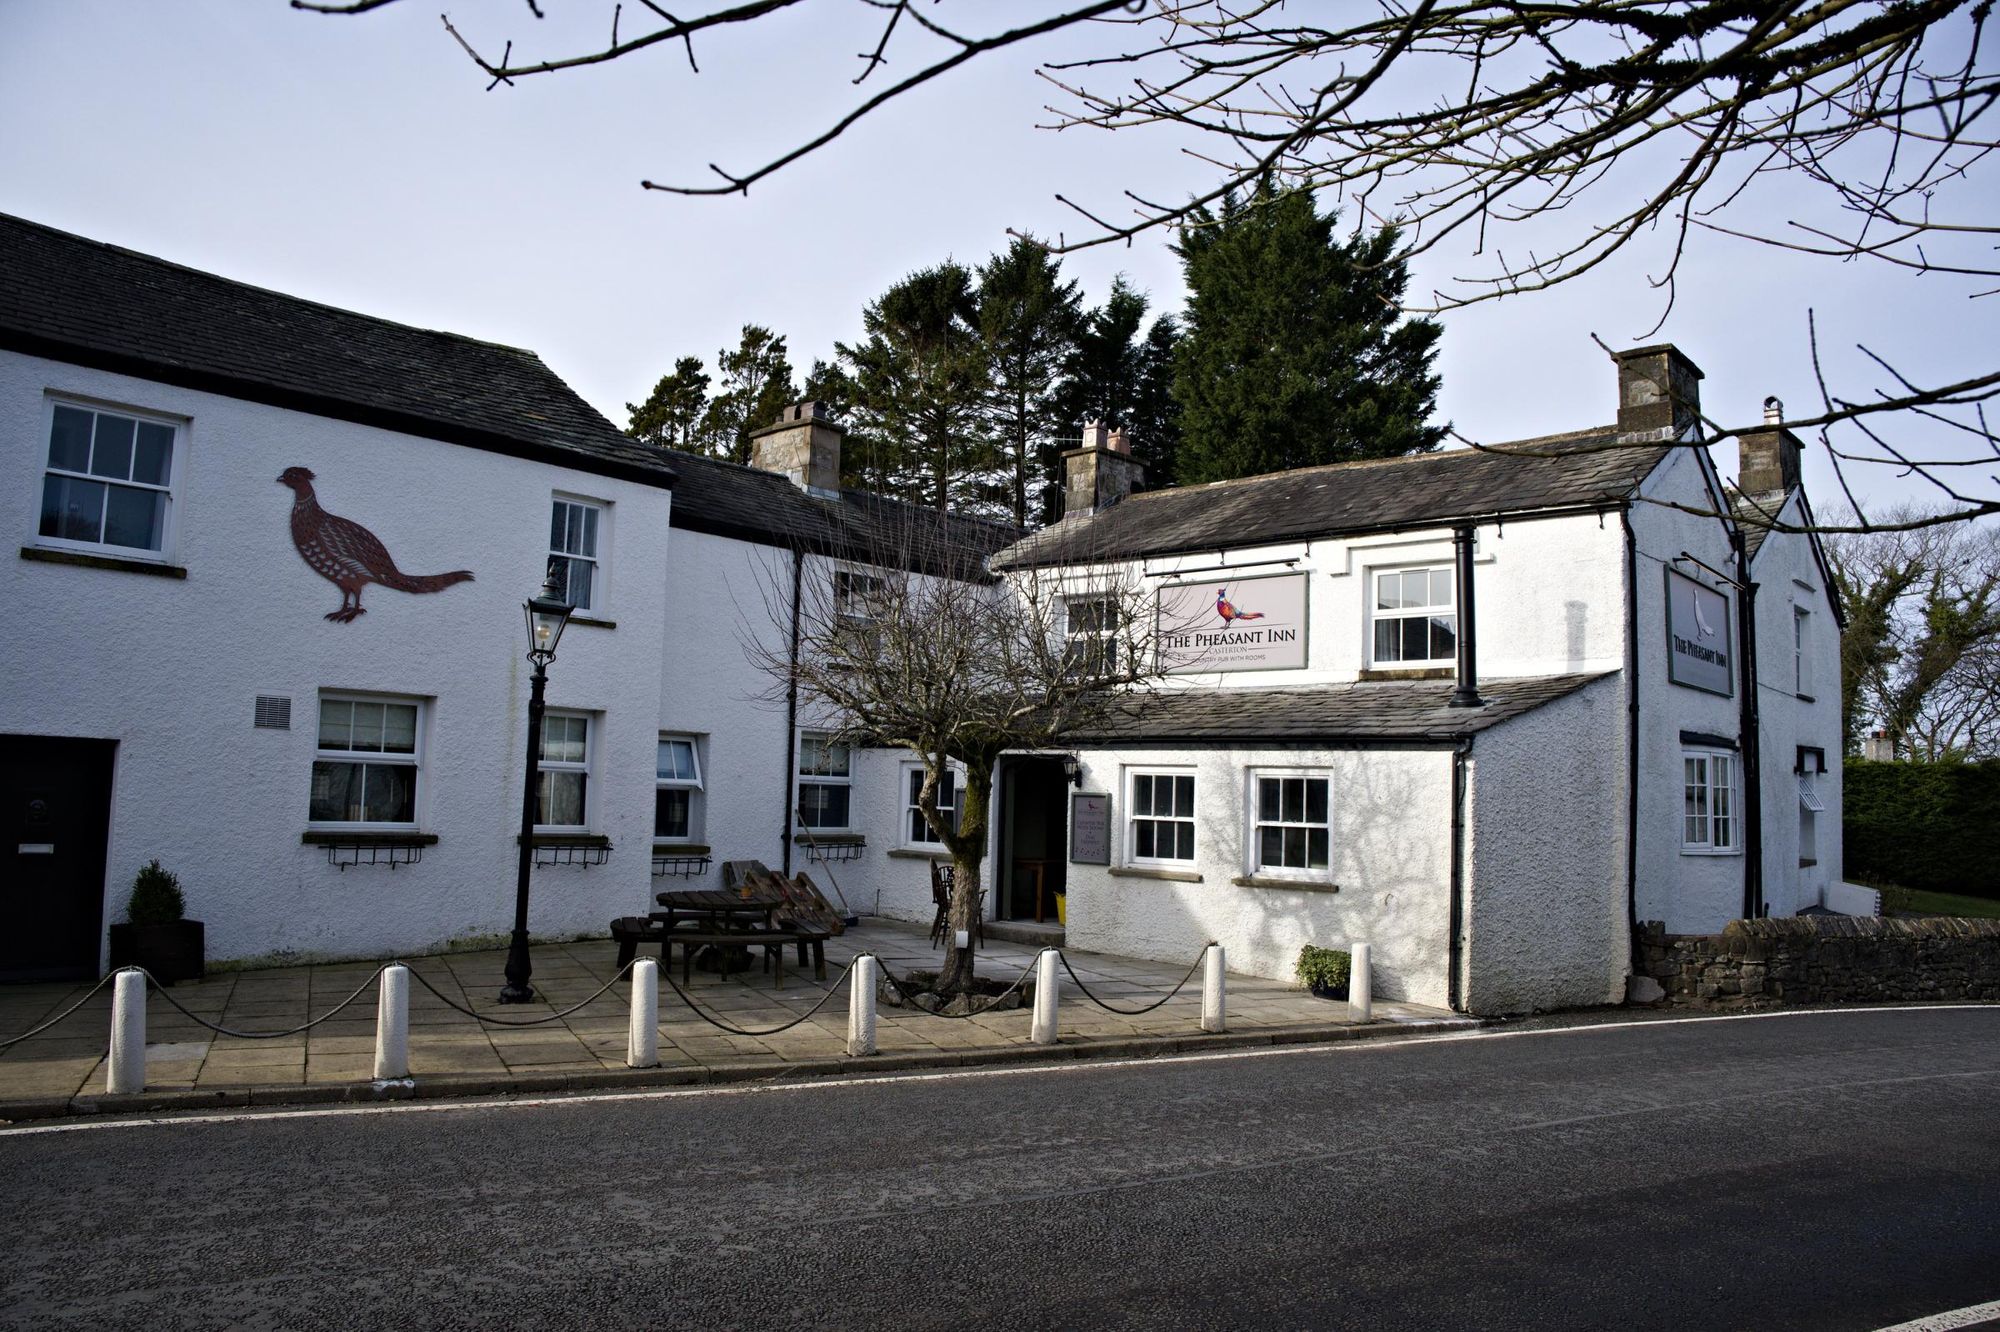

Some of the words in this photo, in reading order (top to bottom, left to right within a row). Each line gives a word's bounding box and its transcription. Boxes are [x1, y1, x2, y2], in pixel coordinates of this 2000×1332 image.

[1167, 636, 1190, 648] THE
[1196, 631, 1263, 647] PHEASANT
[1268, 629, 1295, 643] INN
[1674, 634, 1686, 654] THE
[1208, 646, 1247, 655] CASTERTON
